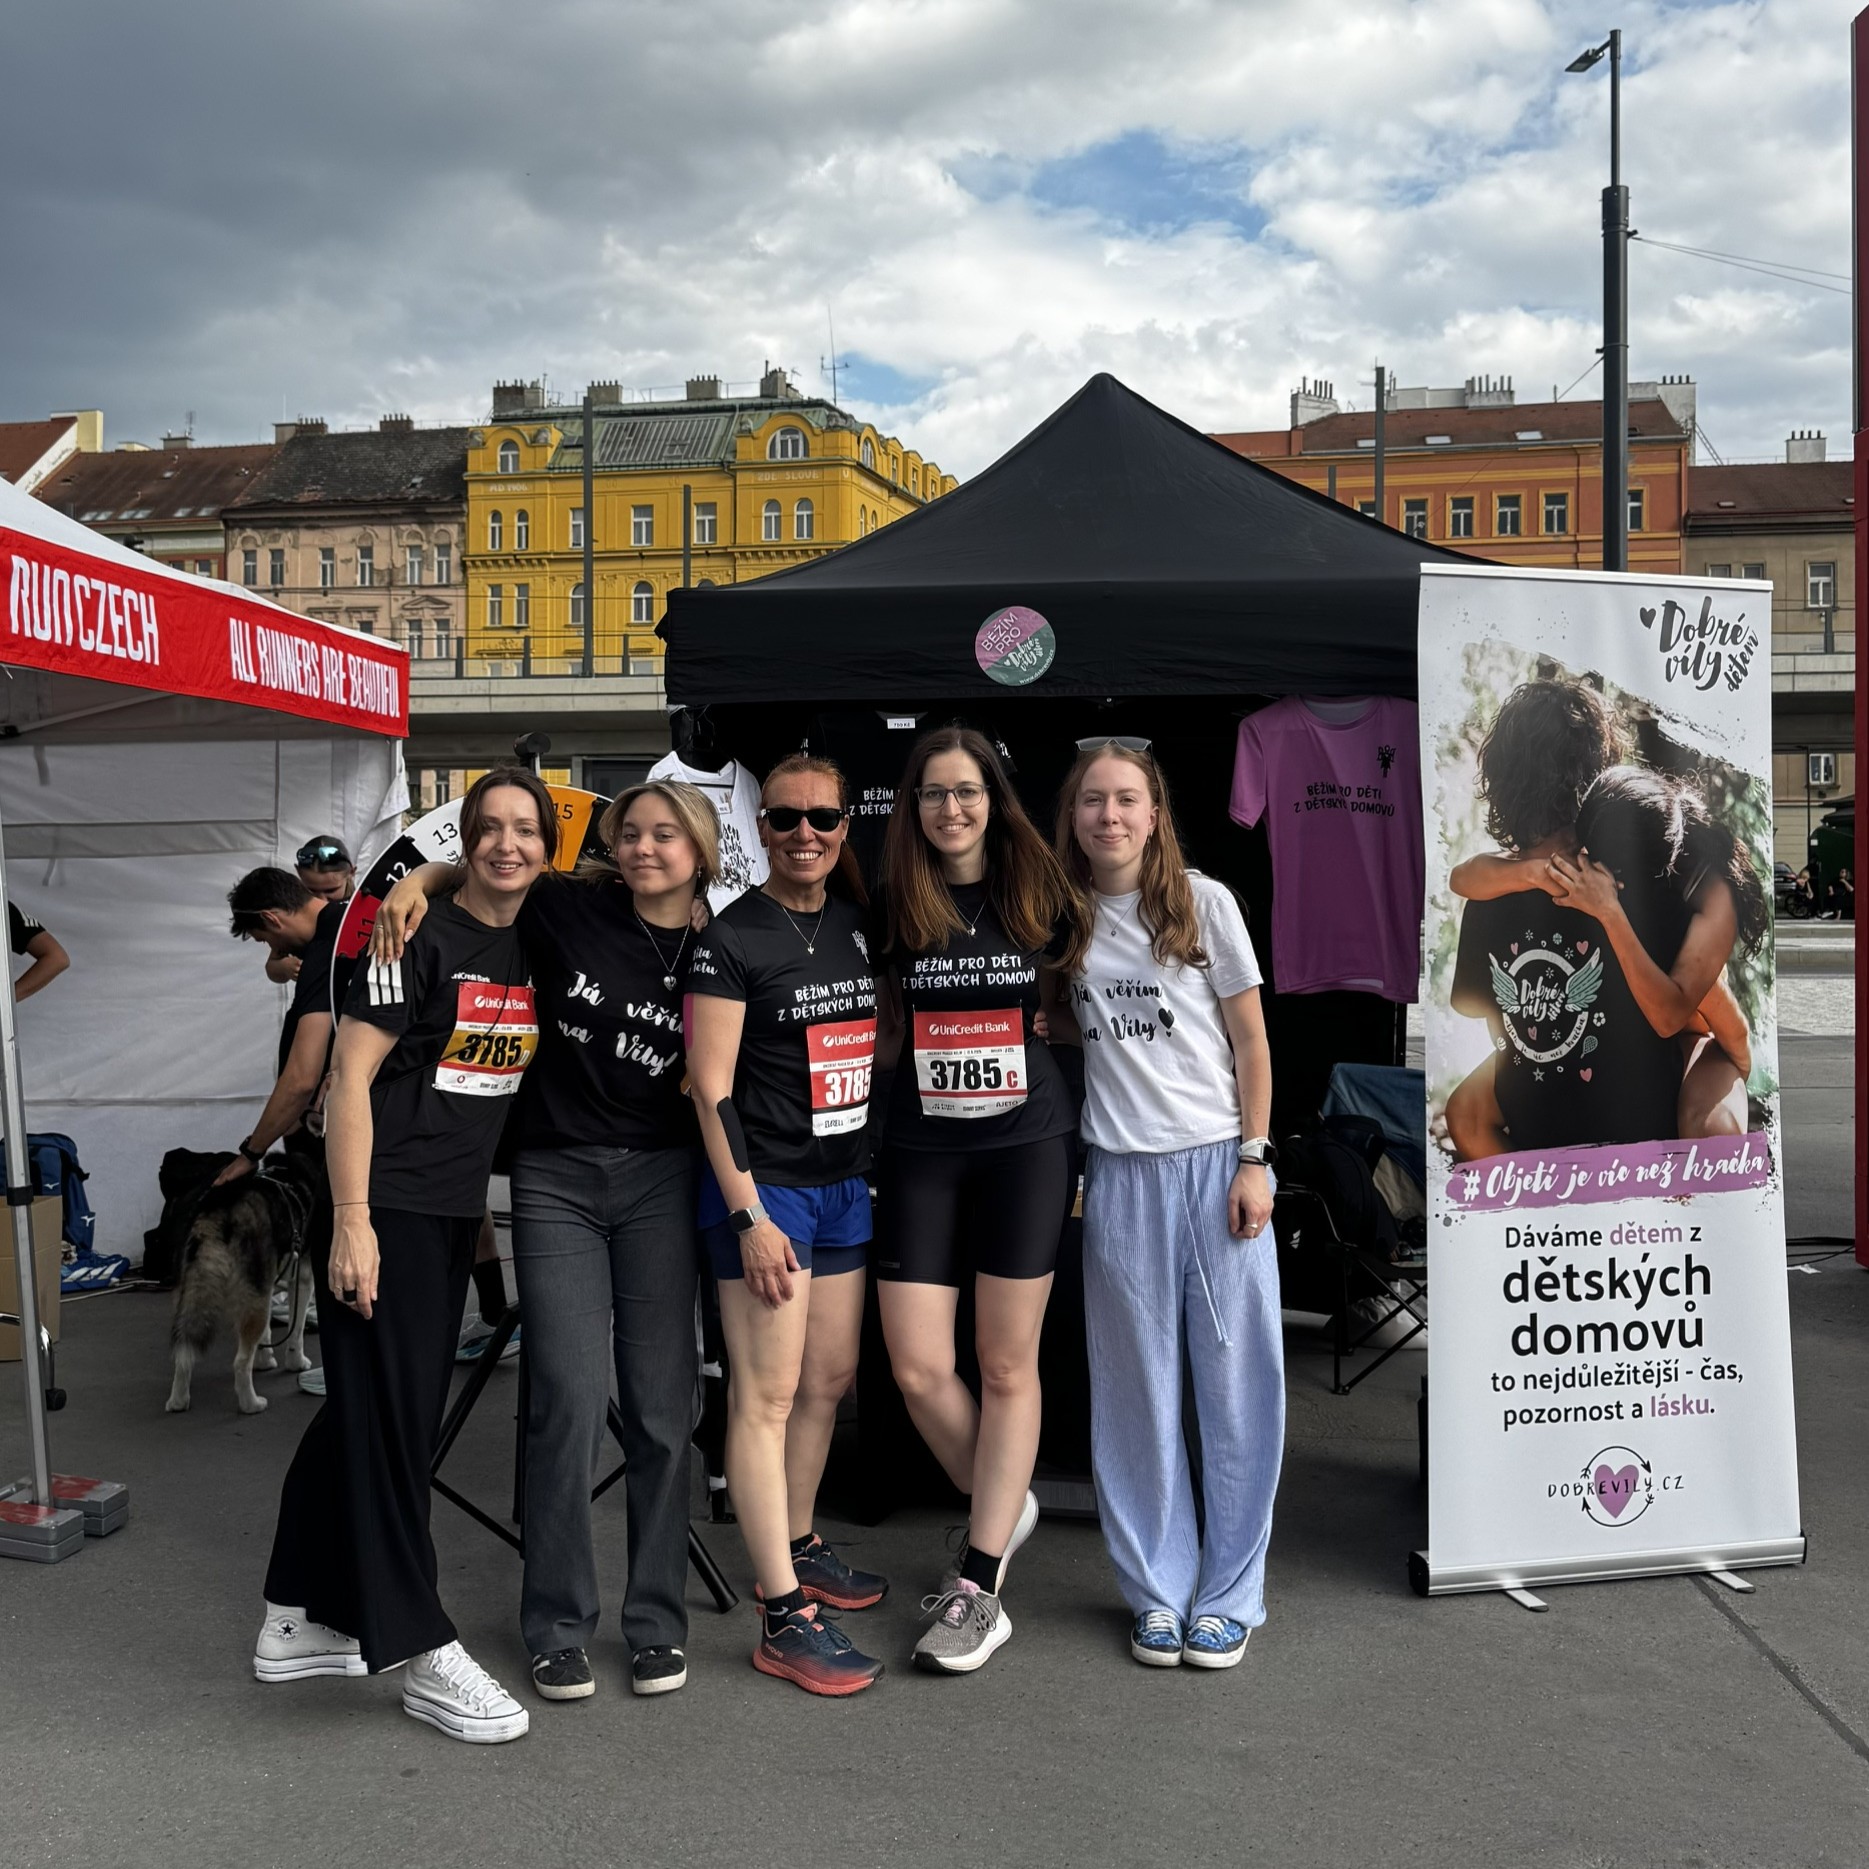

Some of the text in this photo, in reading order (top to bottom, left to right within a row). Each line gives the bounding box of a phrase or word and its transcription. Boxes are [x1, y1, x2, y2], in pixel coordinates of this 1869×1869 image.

[981, 612, 1018, 651] BĚŽÍM
[1660, 595, 1749, 653] Dobré
[995, 627, 1020, 654] PRO
[229, 617, 400, 718] ALL RUNNERS ARE BEAUTIFUL
[1666, 640, 1721, 691] víly
[1724, 629, 1759, 692] dětem
[863, 787, 894, 801] BĚŽÍM
[1307, 782, 1381, 799] BĚŽÍM RO DĚTI
[554, 803, 573, 819] 15
[849, 801, 896, 816] Z DĚTSK
[1294, 802, 1301, 813] Z
[1350, 802, 1395, 817] DOMOVŮ
[433, 822, 458, 846] 13
[385, 861, 412, 883] 12
[357, 917, 375, 939] 11
[915, 952, 1021, 973] BĚŽÍM PRO DĚTI
[567, 970, 605, 1006] Já
[795, 984, 830, 1003] BĚŽÍM
[832, 979, 855, 994] PRO
[902, 966, 1036, 990] Z DĚTSKÝCH DOMOVŮ
[1105, 979, 1162, 1000] věřím
[1520, 975, 1560, 1005] Dobré
[511, 999, 529, 1010] Bank
[777, 1009, 786, 1022] Z
[792, 996, 853, 1020] DĚTSKÝCH
[834, 1032, 869, 1047] UniCredit
[940, 1021, 1010, 1036] UniCredit Bank
[1110, 1013, 1157, 1042] Víly
[458, 1034, 523, 1068] 3785
[557, 1019, 678, 1077] na Víly!
[825, 1066, 872, 1106] 3785
[930, 1058, 1002, 1091] 3785
[1485, 1158, 1559, 1206] Objetí
[1556, 1164, 1594, 1200] je
[1636, 1152, 1678, 1189] než
[1682, 1141, 1765, 1181] hračka
[1505, 1221, 1703, 1249] Dáváme dětem z
[1502, 1251, 1712, 1312] dětských
[1511, 1300, 1704, 1357] domovů
[1491, 1372, 1516, 1393] to
[1523, 1358, 1680, 1395] nejdůležitější
[1699, 1357, 1744, 1384] čas,
[1503, 1393, 1716, 1432] pozornost a lásku.
[1548, 1474, 1685, 1499] DOBREVILY.CZ
